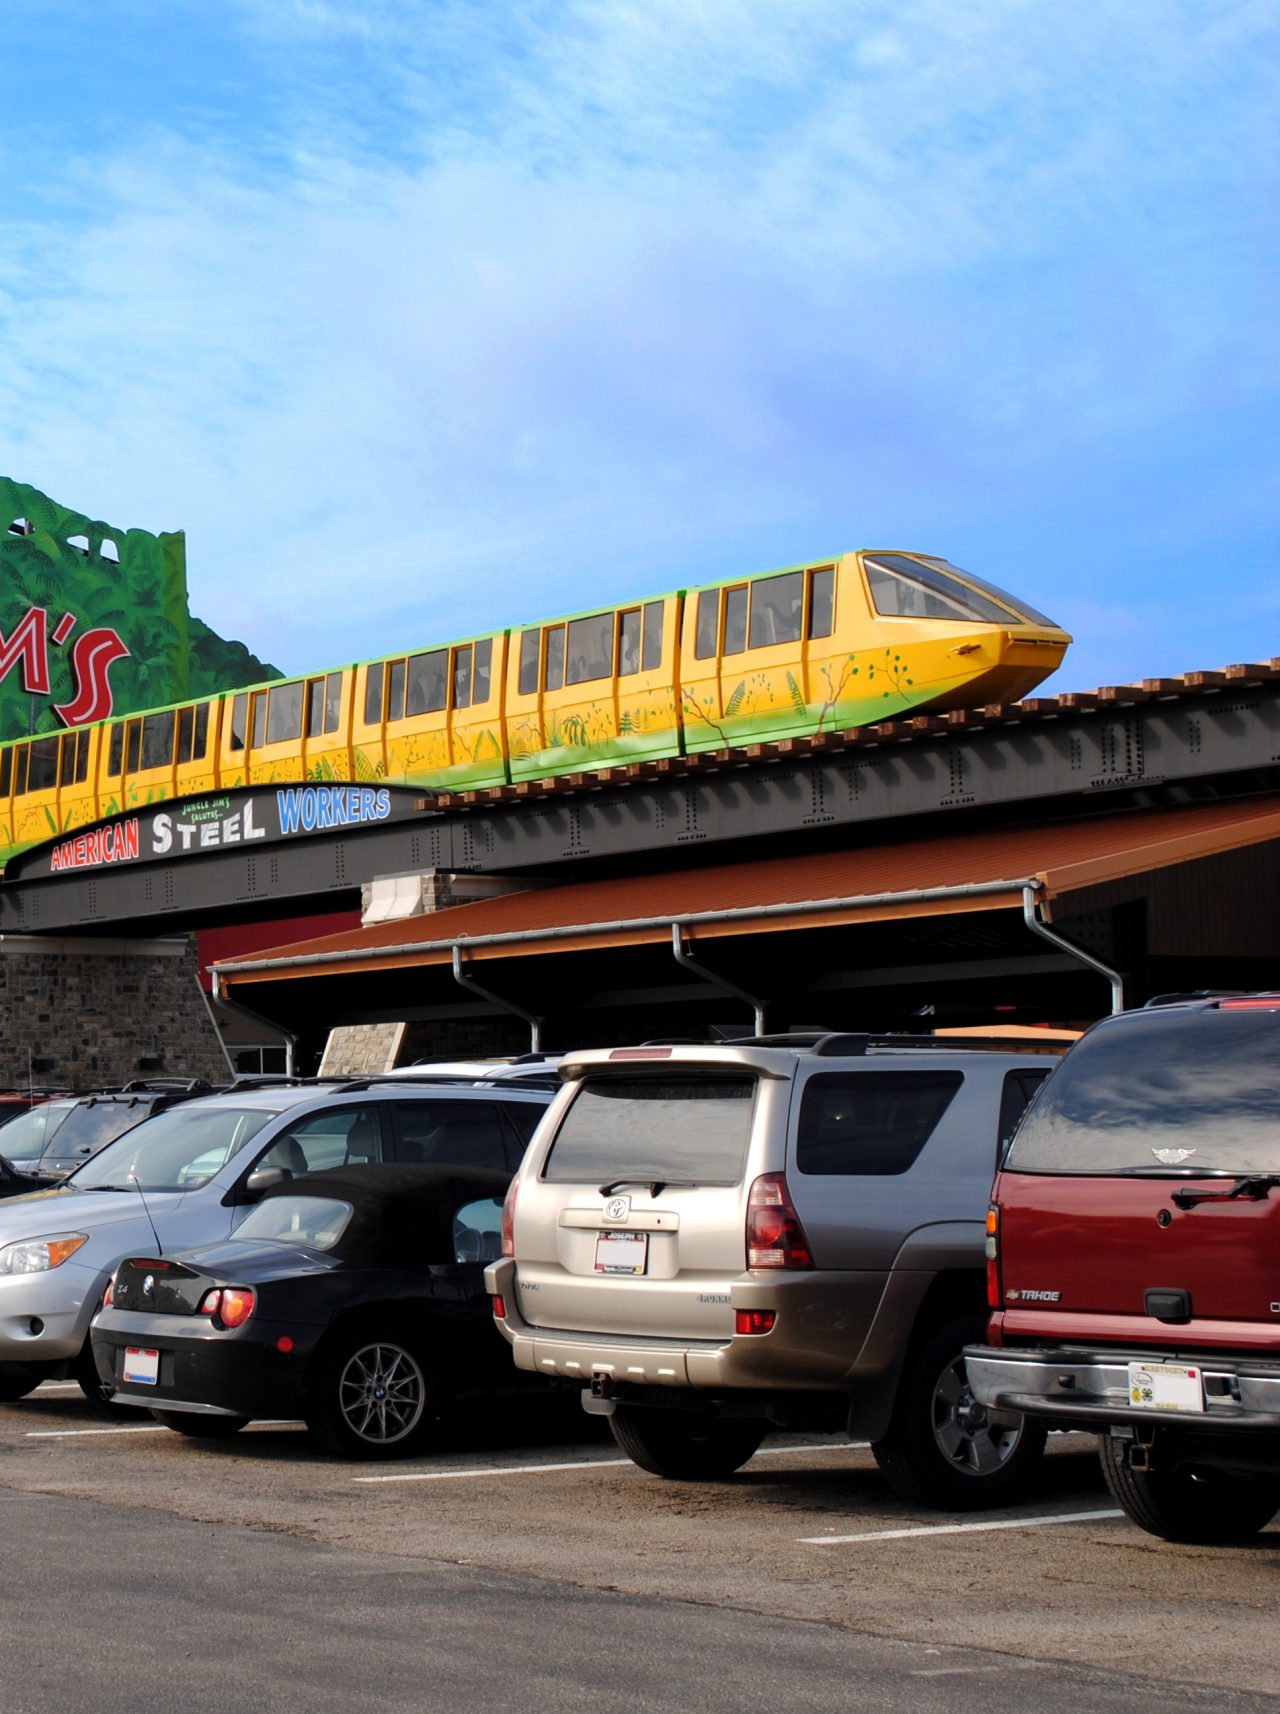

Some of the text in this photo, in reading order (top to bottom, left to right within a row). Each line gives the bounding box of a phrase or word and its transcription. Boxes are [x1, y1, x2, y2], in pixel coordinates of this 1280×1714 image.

[181, 797, 231, 816] JUNGLE JIM'S
[51, 787, 391, 872] AMERICAN STEEL WORKERS
[1021, 1289, 1060, 1302] TAHOE
